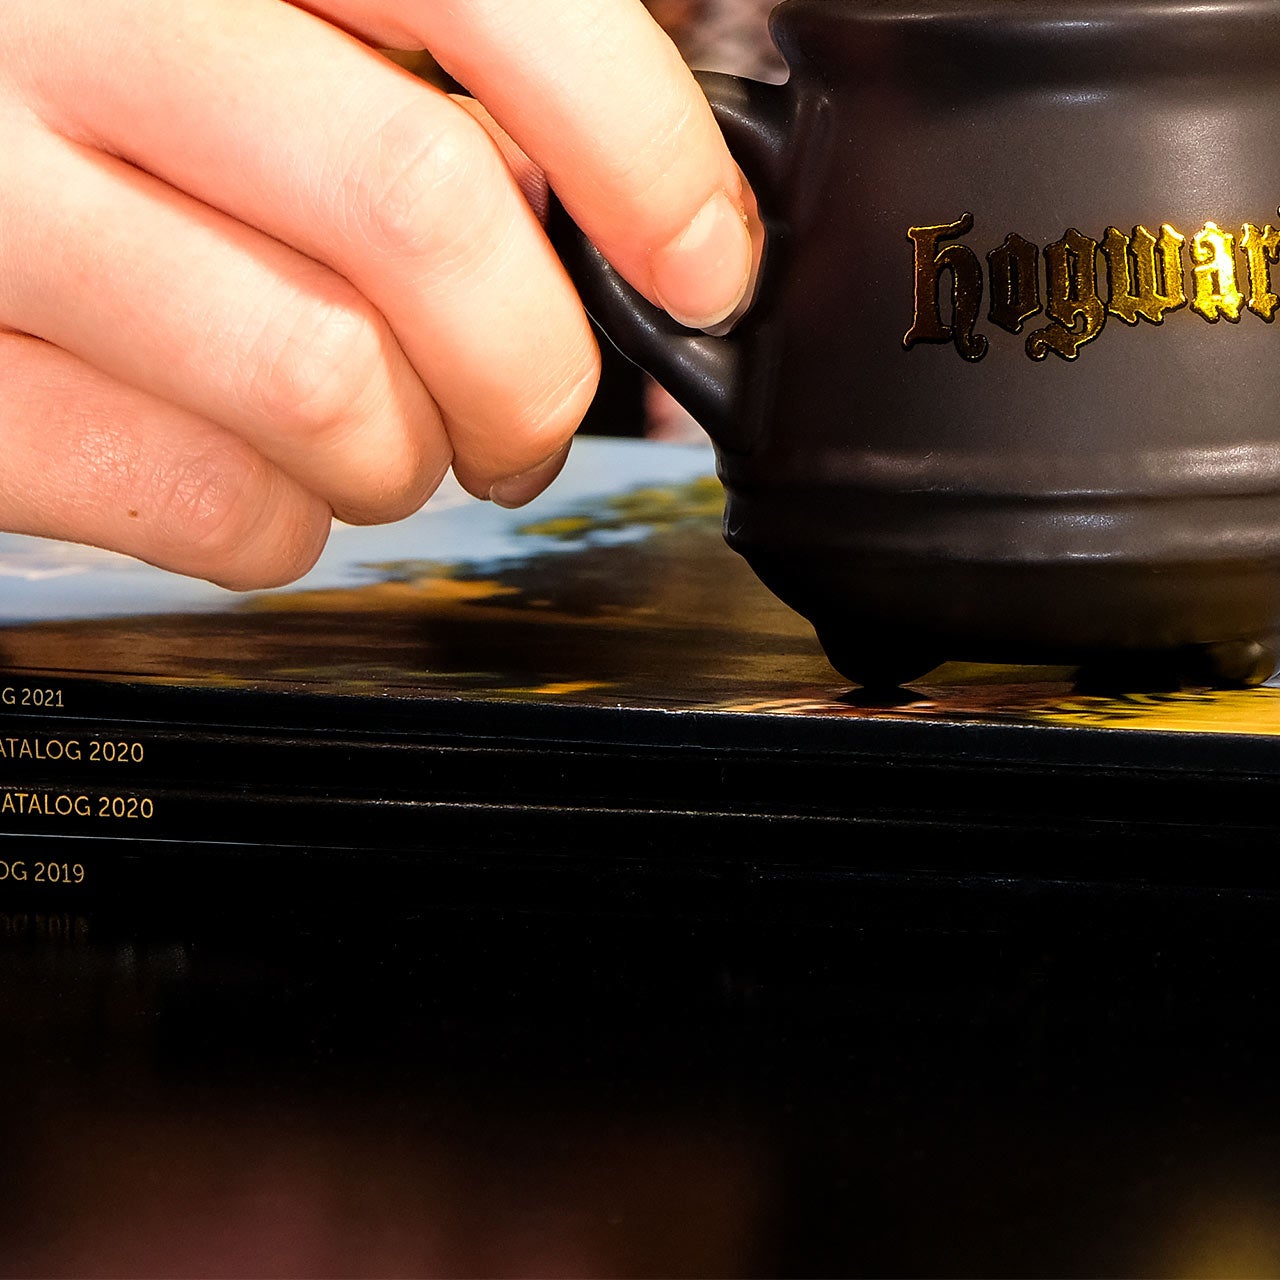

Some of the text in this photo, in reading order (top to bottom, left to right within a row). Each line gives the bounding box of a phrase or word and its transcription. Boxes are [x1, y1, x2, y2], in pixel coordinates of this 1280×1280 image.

[21, 688, 65, 707] 2021
[89, 741, 145, 763] 2020
[1, 792, 154, 819] ATALOG 2020
[34, 862, 85, 883] 2019
